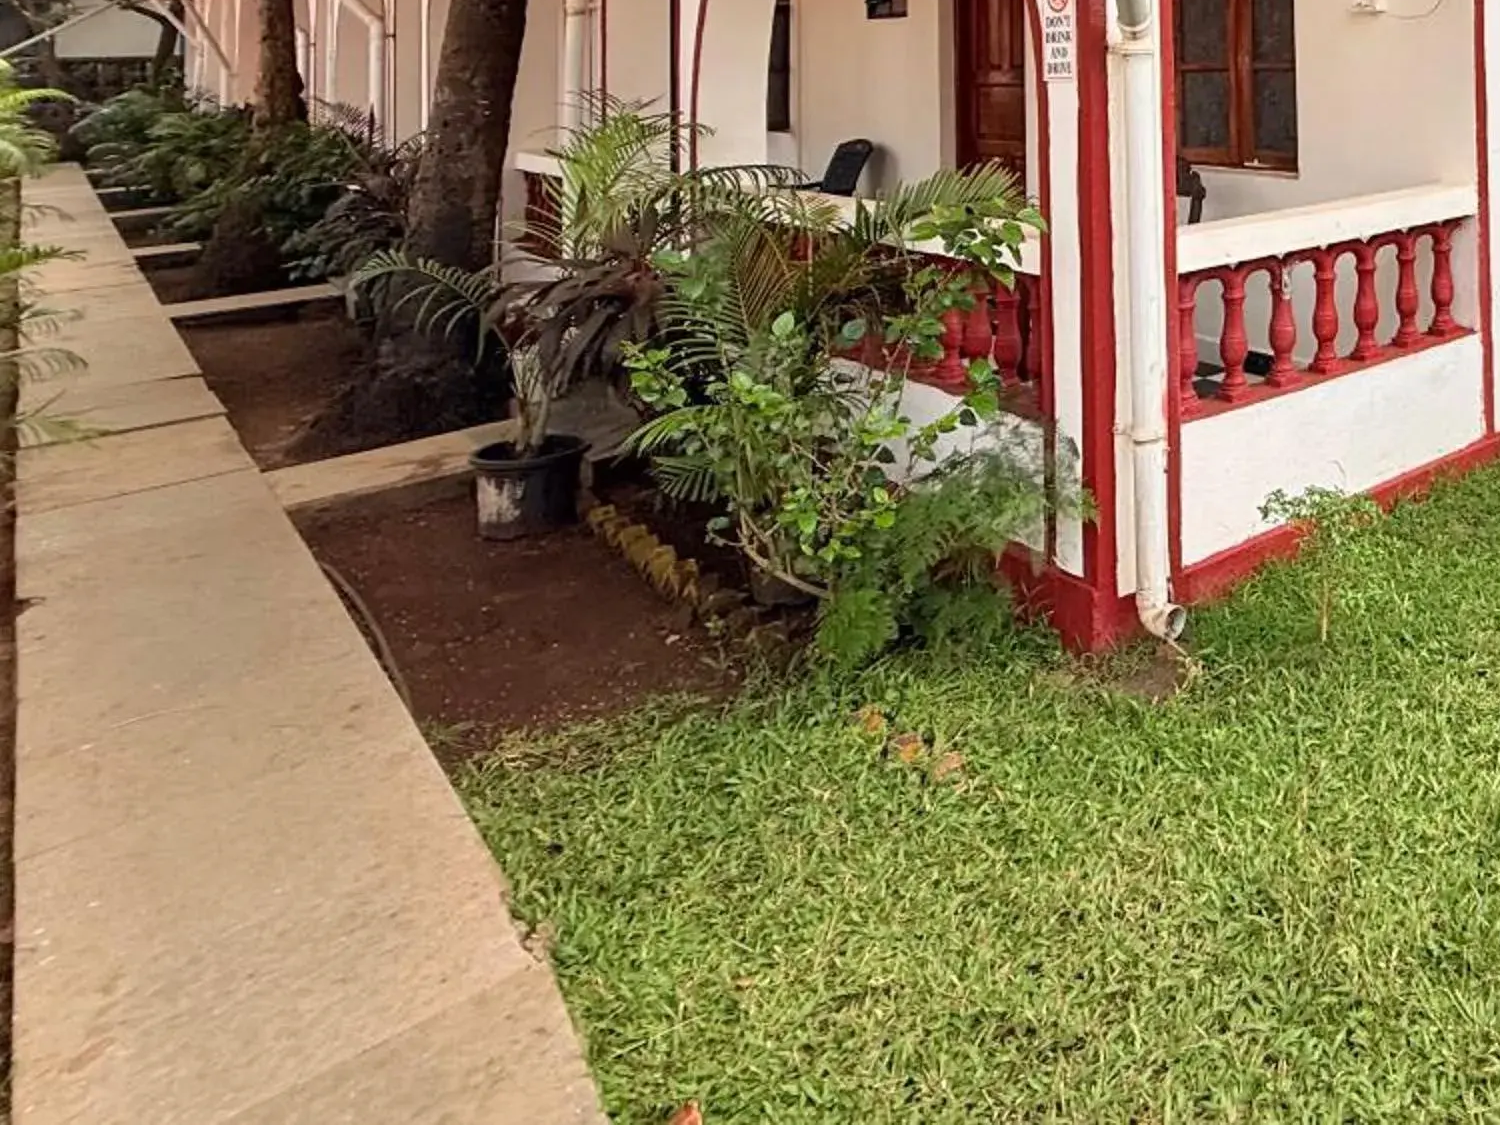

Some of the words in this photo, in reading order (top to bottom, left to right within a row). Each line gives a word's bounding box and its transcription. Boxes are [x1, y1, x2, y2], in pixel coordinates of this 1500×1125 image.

[1045, 15, 1070, 28] DON'T
[1045, 31, 1071, 43] DRINK
[1050, 46, 1068, 59] AND
[1047, 61, 1072, 75] DRIVE
